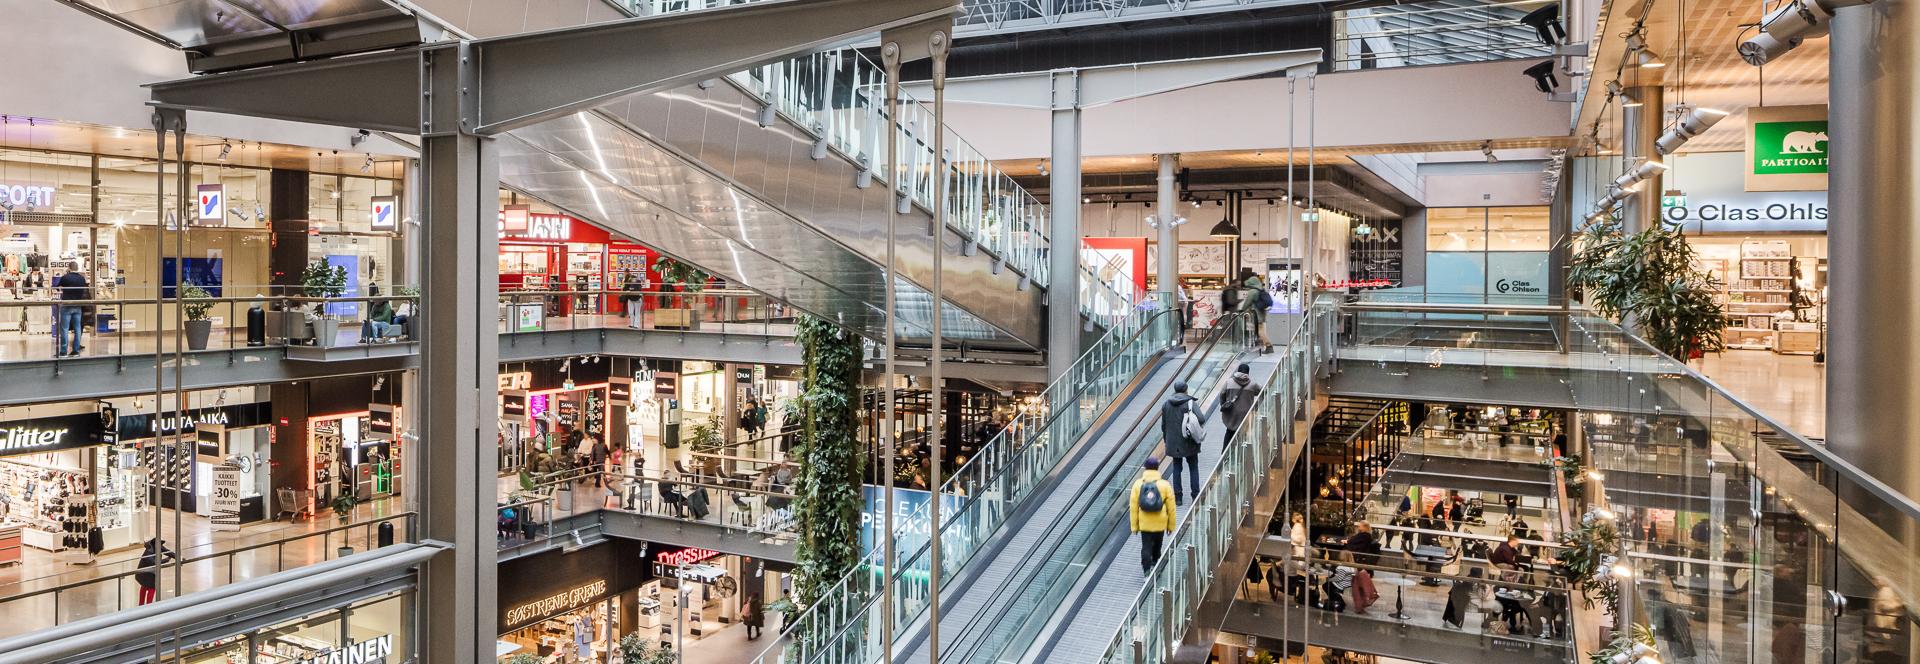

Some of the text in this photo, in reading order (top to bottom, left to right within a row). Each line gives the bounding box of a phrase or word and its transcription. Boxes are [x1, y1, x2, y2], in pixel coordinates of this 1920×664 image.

[1698, 203, 1827, 221] Clas Ohls
[507, 580, 606, 626] SØSTRENE GRENE
